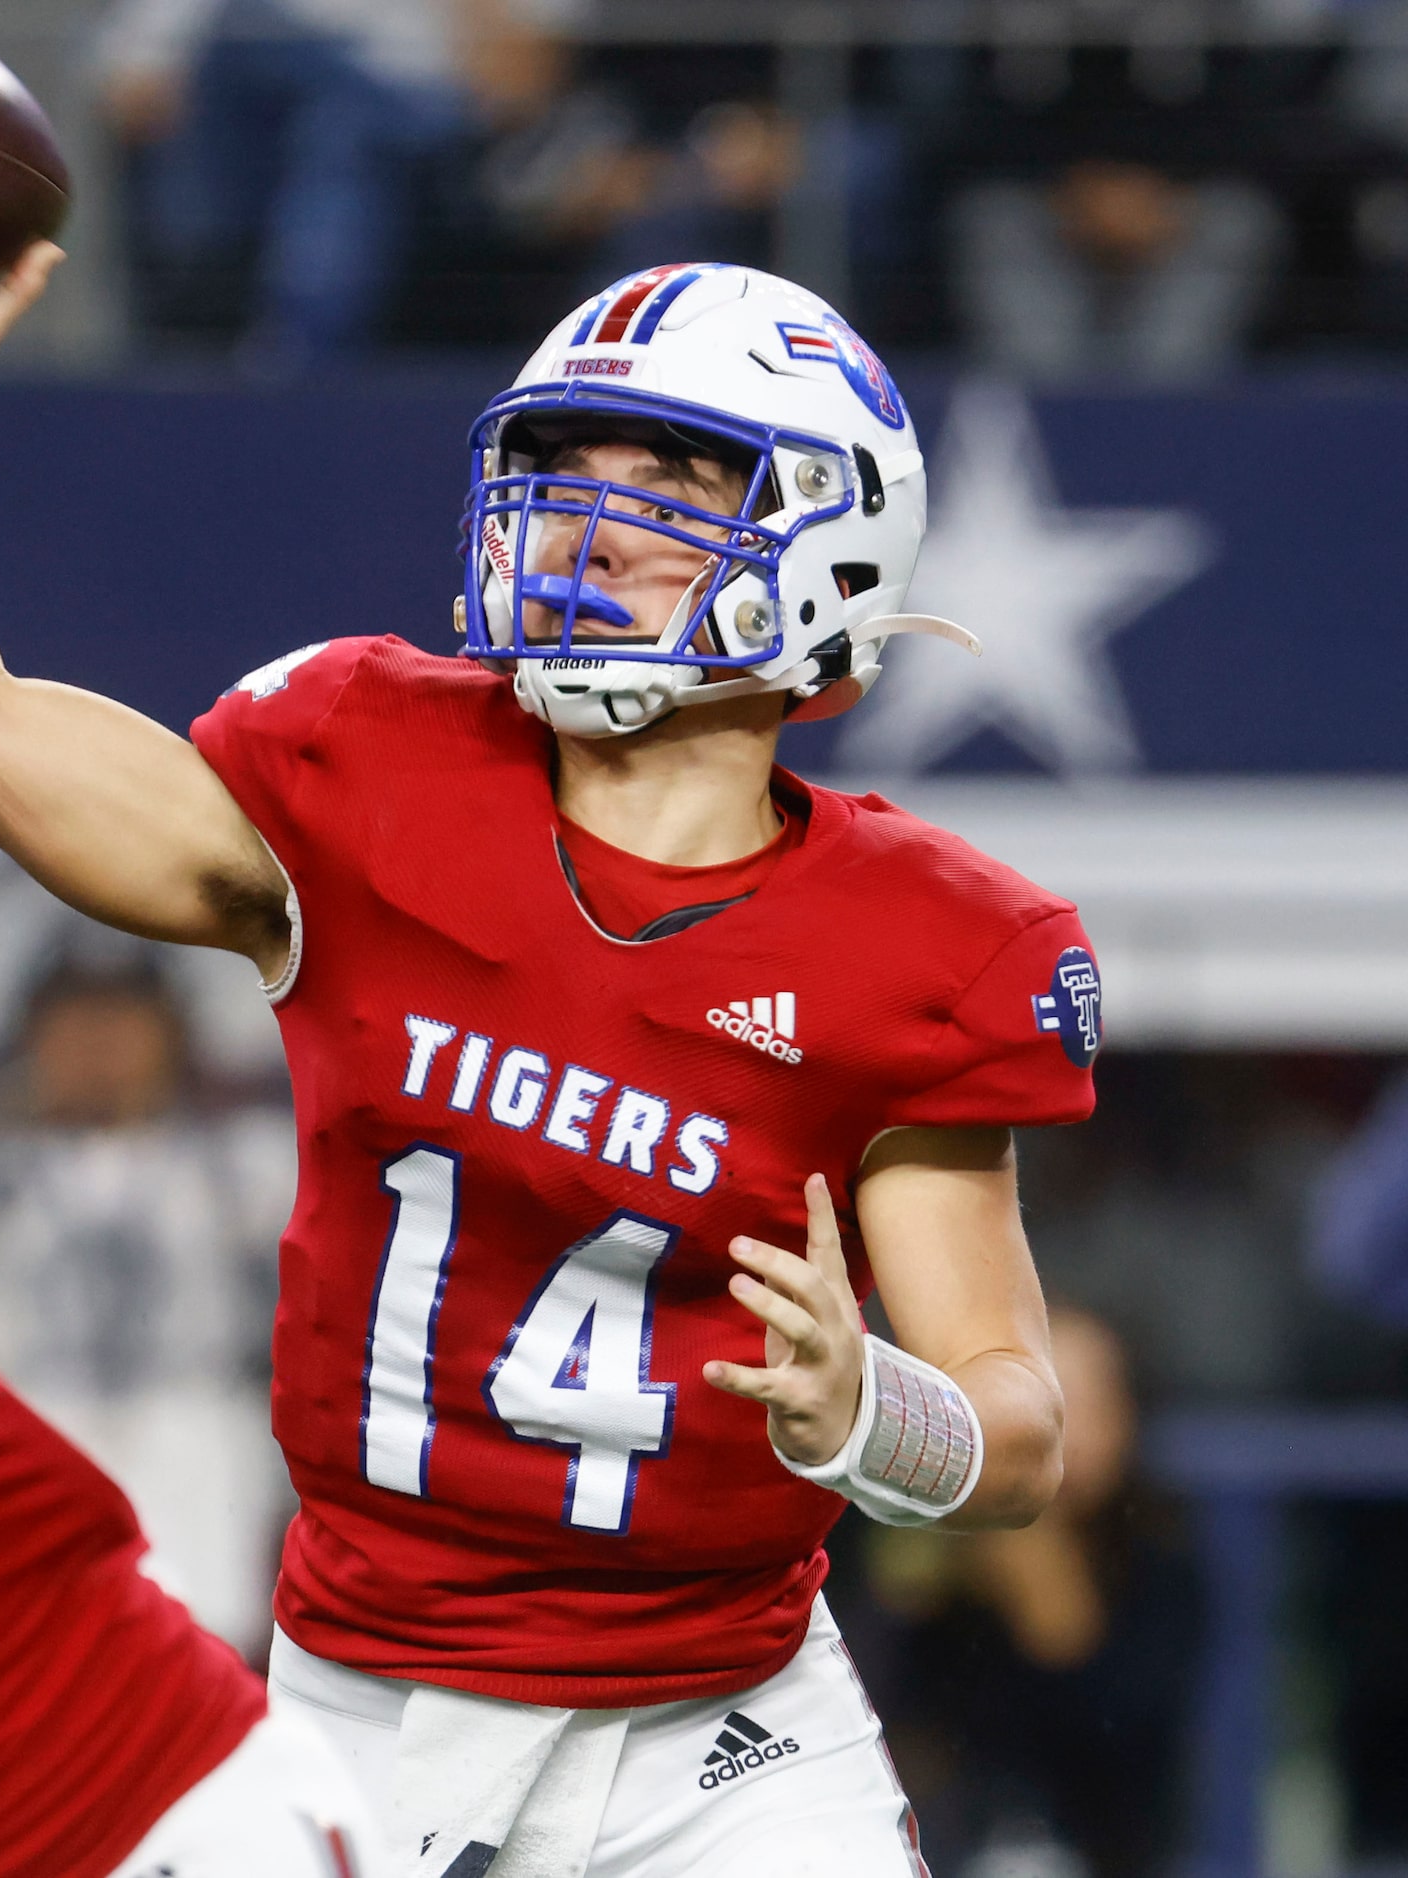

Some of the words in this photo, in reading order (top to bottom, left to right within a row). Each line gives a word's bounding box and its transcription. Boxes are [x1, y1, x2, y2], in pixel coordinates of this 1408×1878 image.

[563, 358, 633, 378] TIGERS
[480, 520, 515, 585] Riddell
[705, 1008, 804, 1065] adidas
[400, 1013, 730, 1198] TIGERS
[358, 1139, 683, 1537] 14
[698, 1737, 801, 1791] adidas
